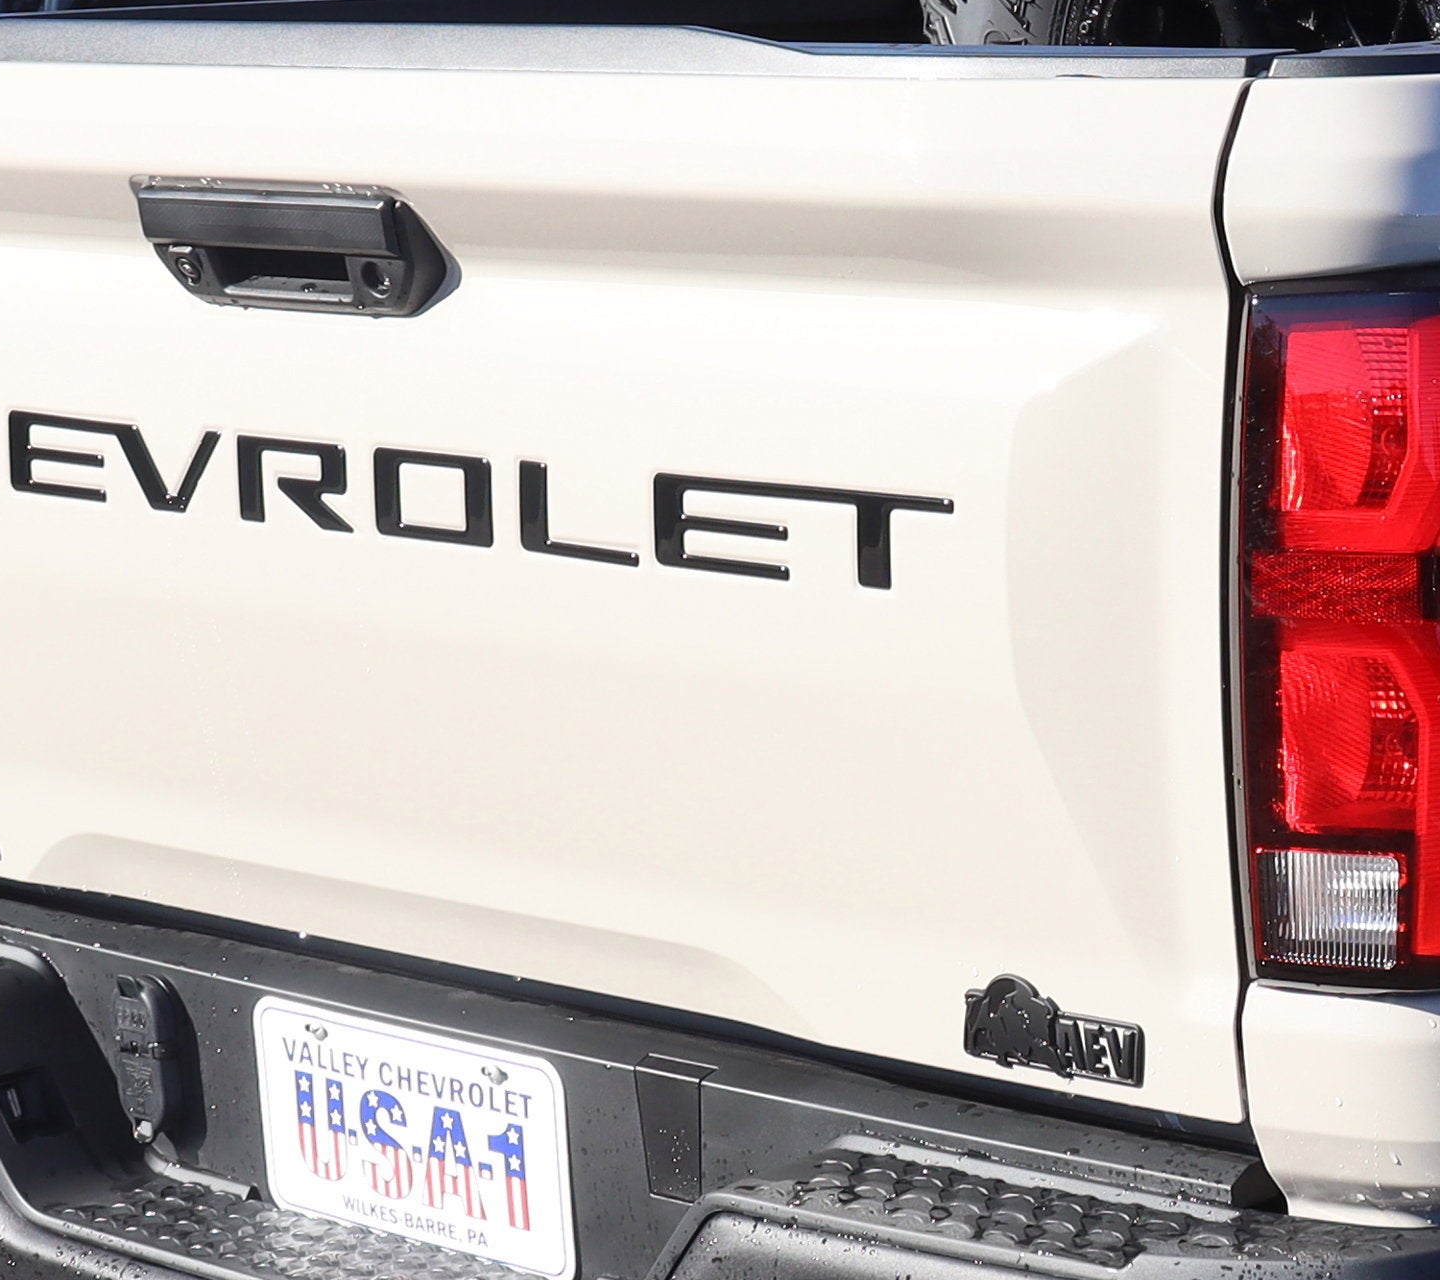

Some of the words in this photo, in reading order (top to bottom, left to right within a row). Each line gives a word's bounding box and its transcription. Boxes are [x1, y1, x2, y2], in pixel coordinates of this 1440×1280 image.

[282, 1036, 369, 1081] VALLEY
[378, 1061, 533, 1119] CHEVROLET
[1056, 1018, 1138, 1083] AEV
[341, 1194, 463, 1243] WILKES-BARRE,
[467, 1229, 489, 1249] PA
